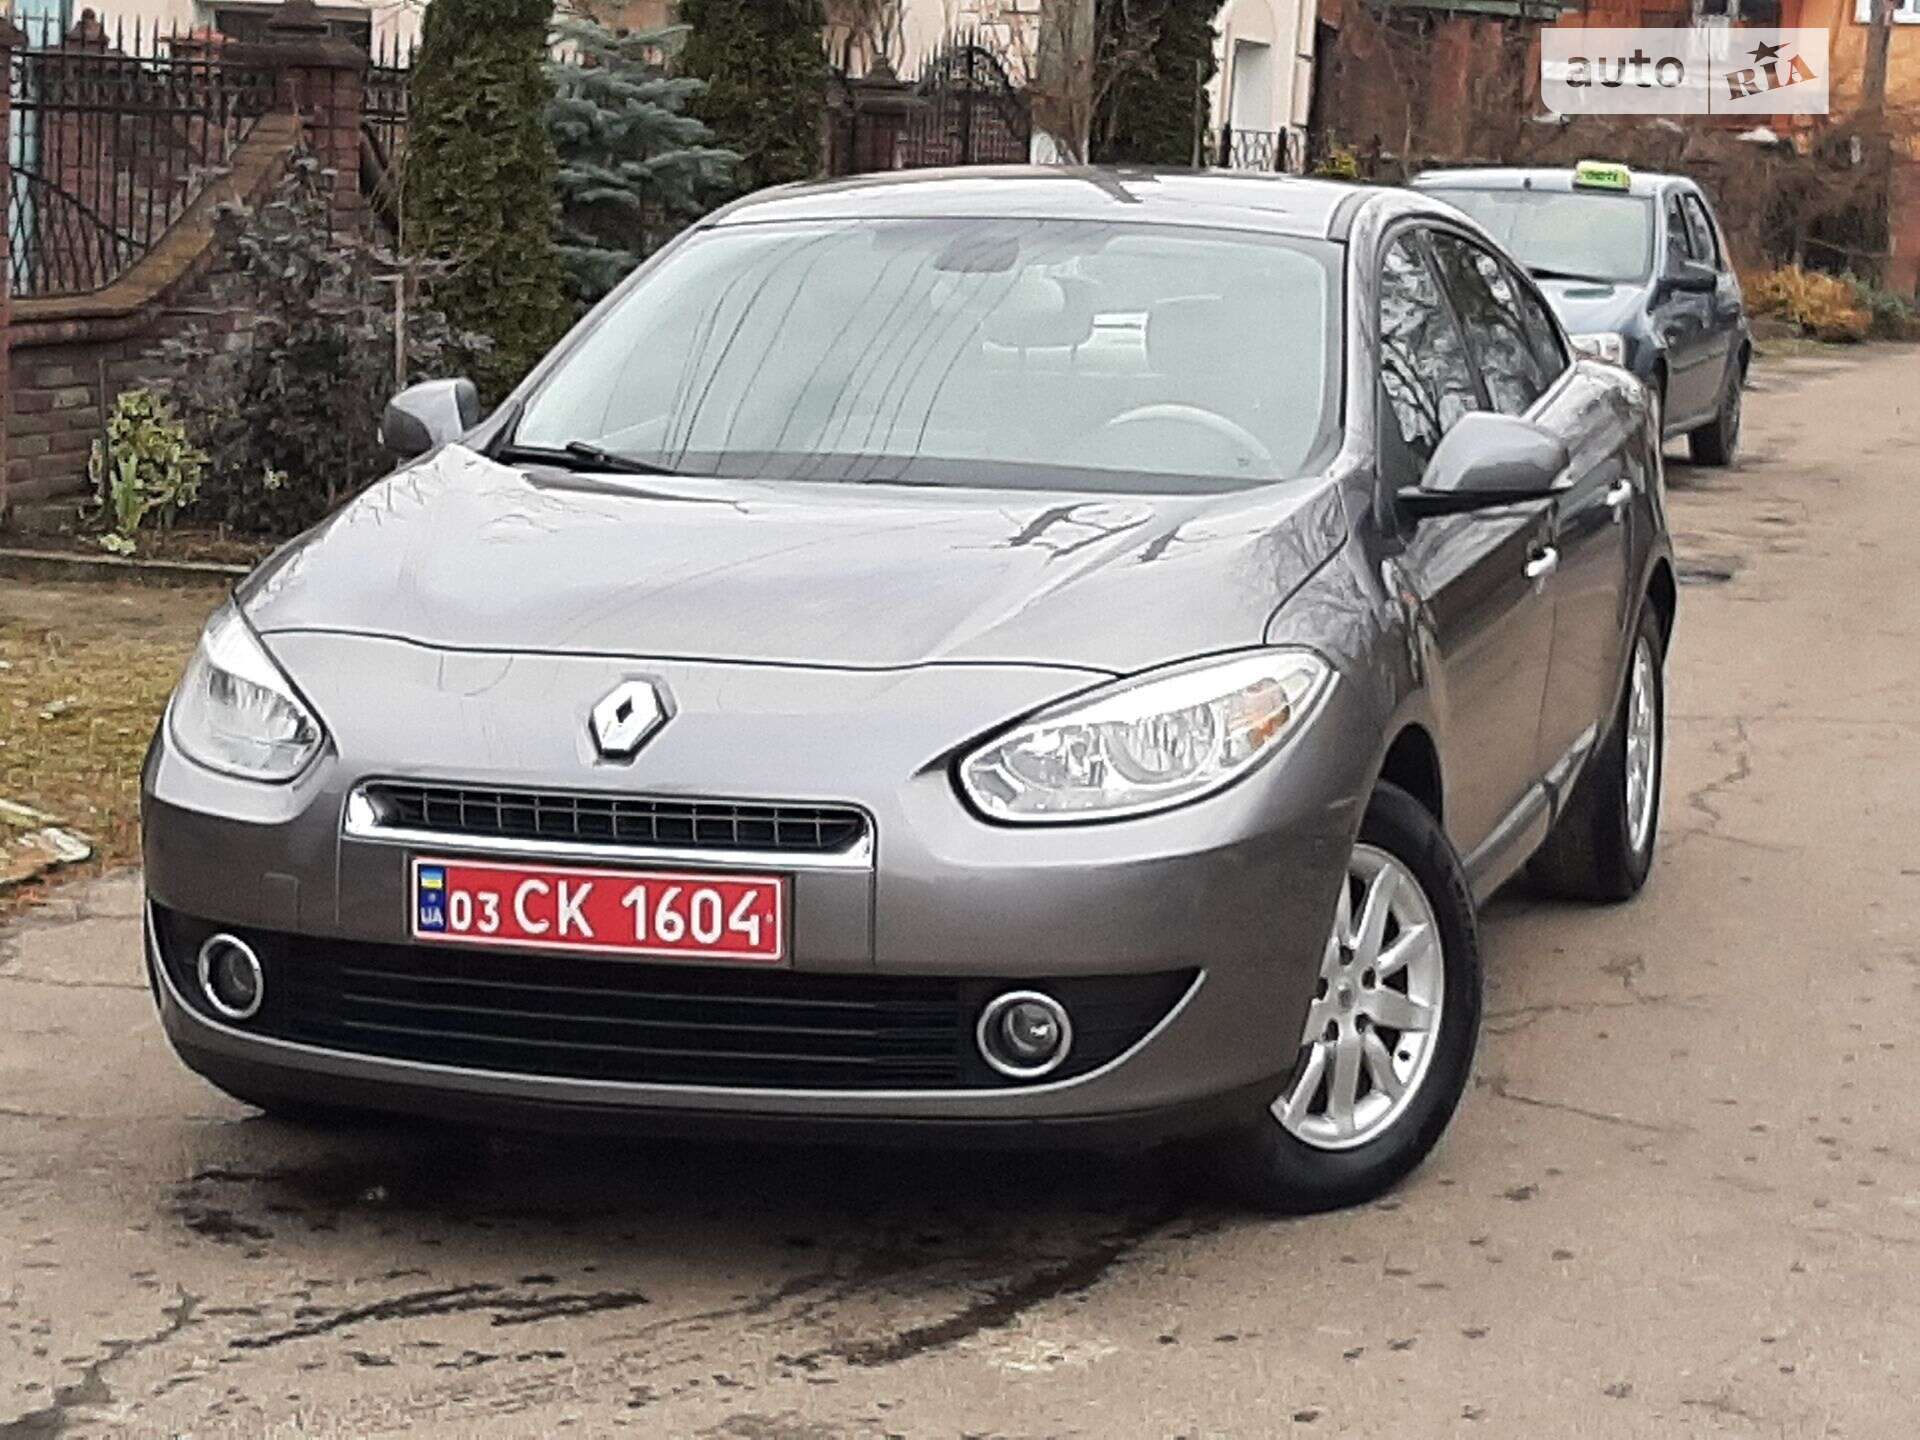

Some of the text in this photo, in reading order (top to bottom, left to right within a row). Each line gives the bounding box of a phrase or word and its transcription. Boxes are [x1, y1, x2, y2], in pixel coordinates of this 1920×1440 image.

[420, 879, 760, 946] UA 03 CK 1604
